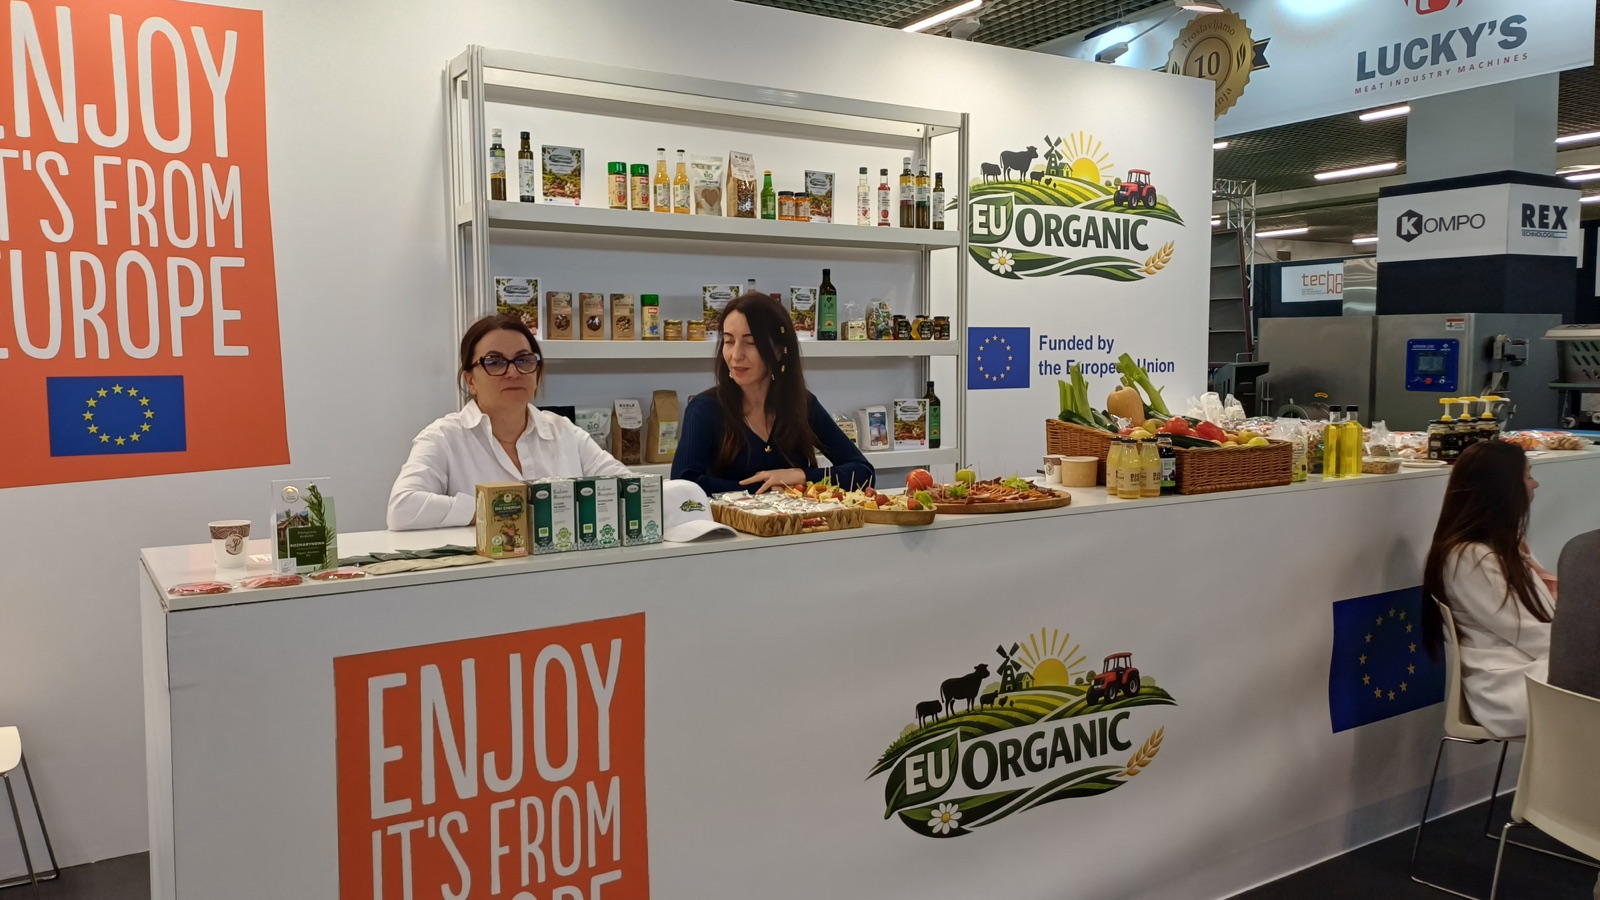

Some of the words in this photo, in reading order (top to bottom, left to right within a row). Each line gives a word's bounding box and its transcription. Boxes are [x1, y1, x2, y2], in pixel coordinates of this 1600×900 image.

[1181, 19, 1235, 49] Proslavljamo
[1356, 14, 1528, 82] LUCKY'S
[0, 0, 237, 157] NJOY
[1194, 50, 1221, 79] 10
[1354, 82, 1384, 95] MEAT
[1389, 68, 1451, 88] INDUSTRY
[1457, 52, 1529, 74] MACHINES
[93, 154, 244, 249] FROM
[1400, 212, 1486, 236] KOMPO
[1521, 202, 1569, 231] REX
[972, 202, 1008, 237] EU
[1014, 207, 1150, 252] ORGANIC
[0, 248, 250, 361] UROPE
[1038, 334, 1094, 351] Funded
[1097, 334, 1115, 355] by
[1038, 360, 1062, 376] the
[1066, 359, 1123, 378] Europe
[1137, 358, 1175, 374] Union
[367, 637, 623, 820] ENJOY
[904, 747, 951, 796] EU
[961, 710, 1133, 791] ORGANIC
[371, 810, 472, 900] IT'S
[490, 775, 621, 896] FROM
